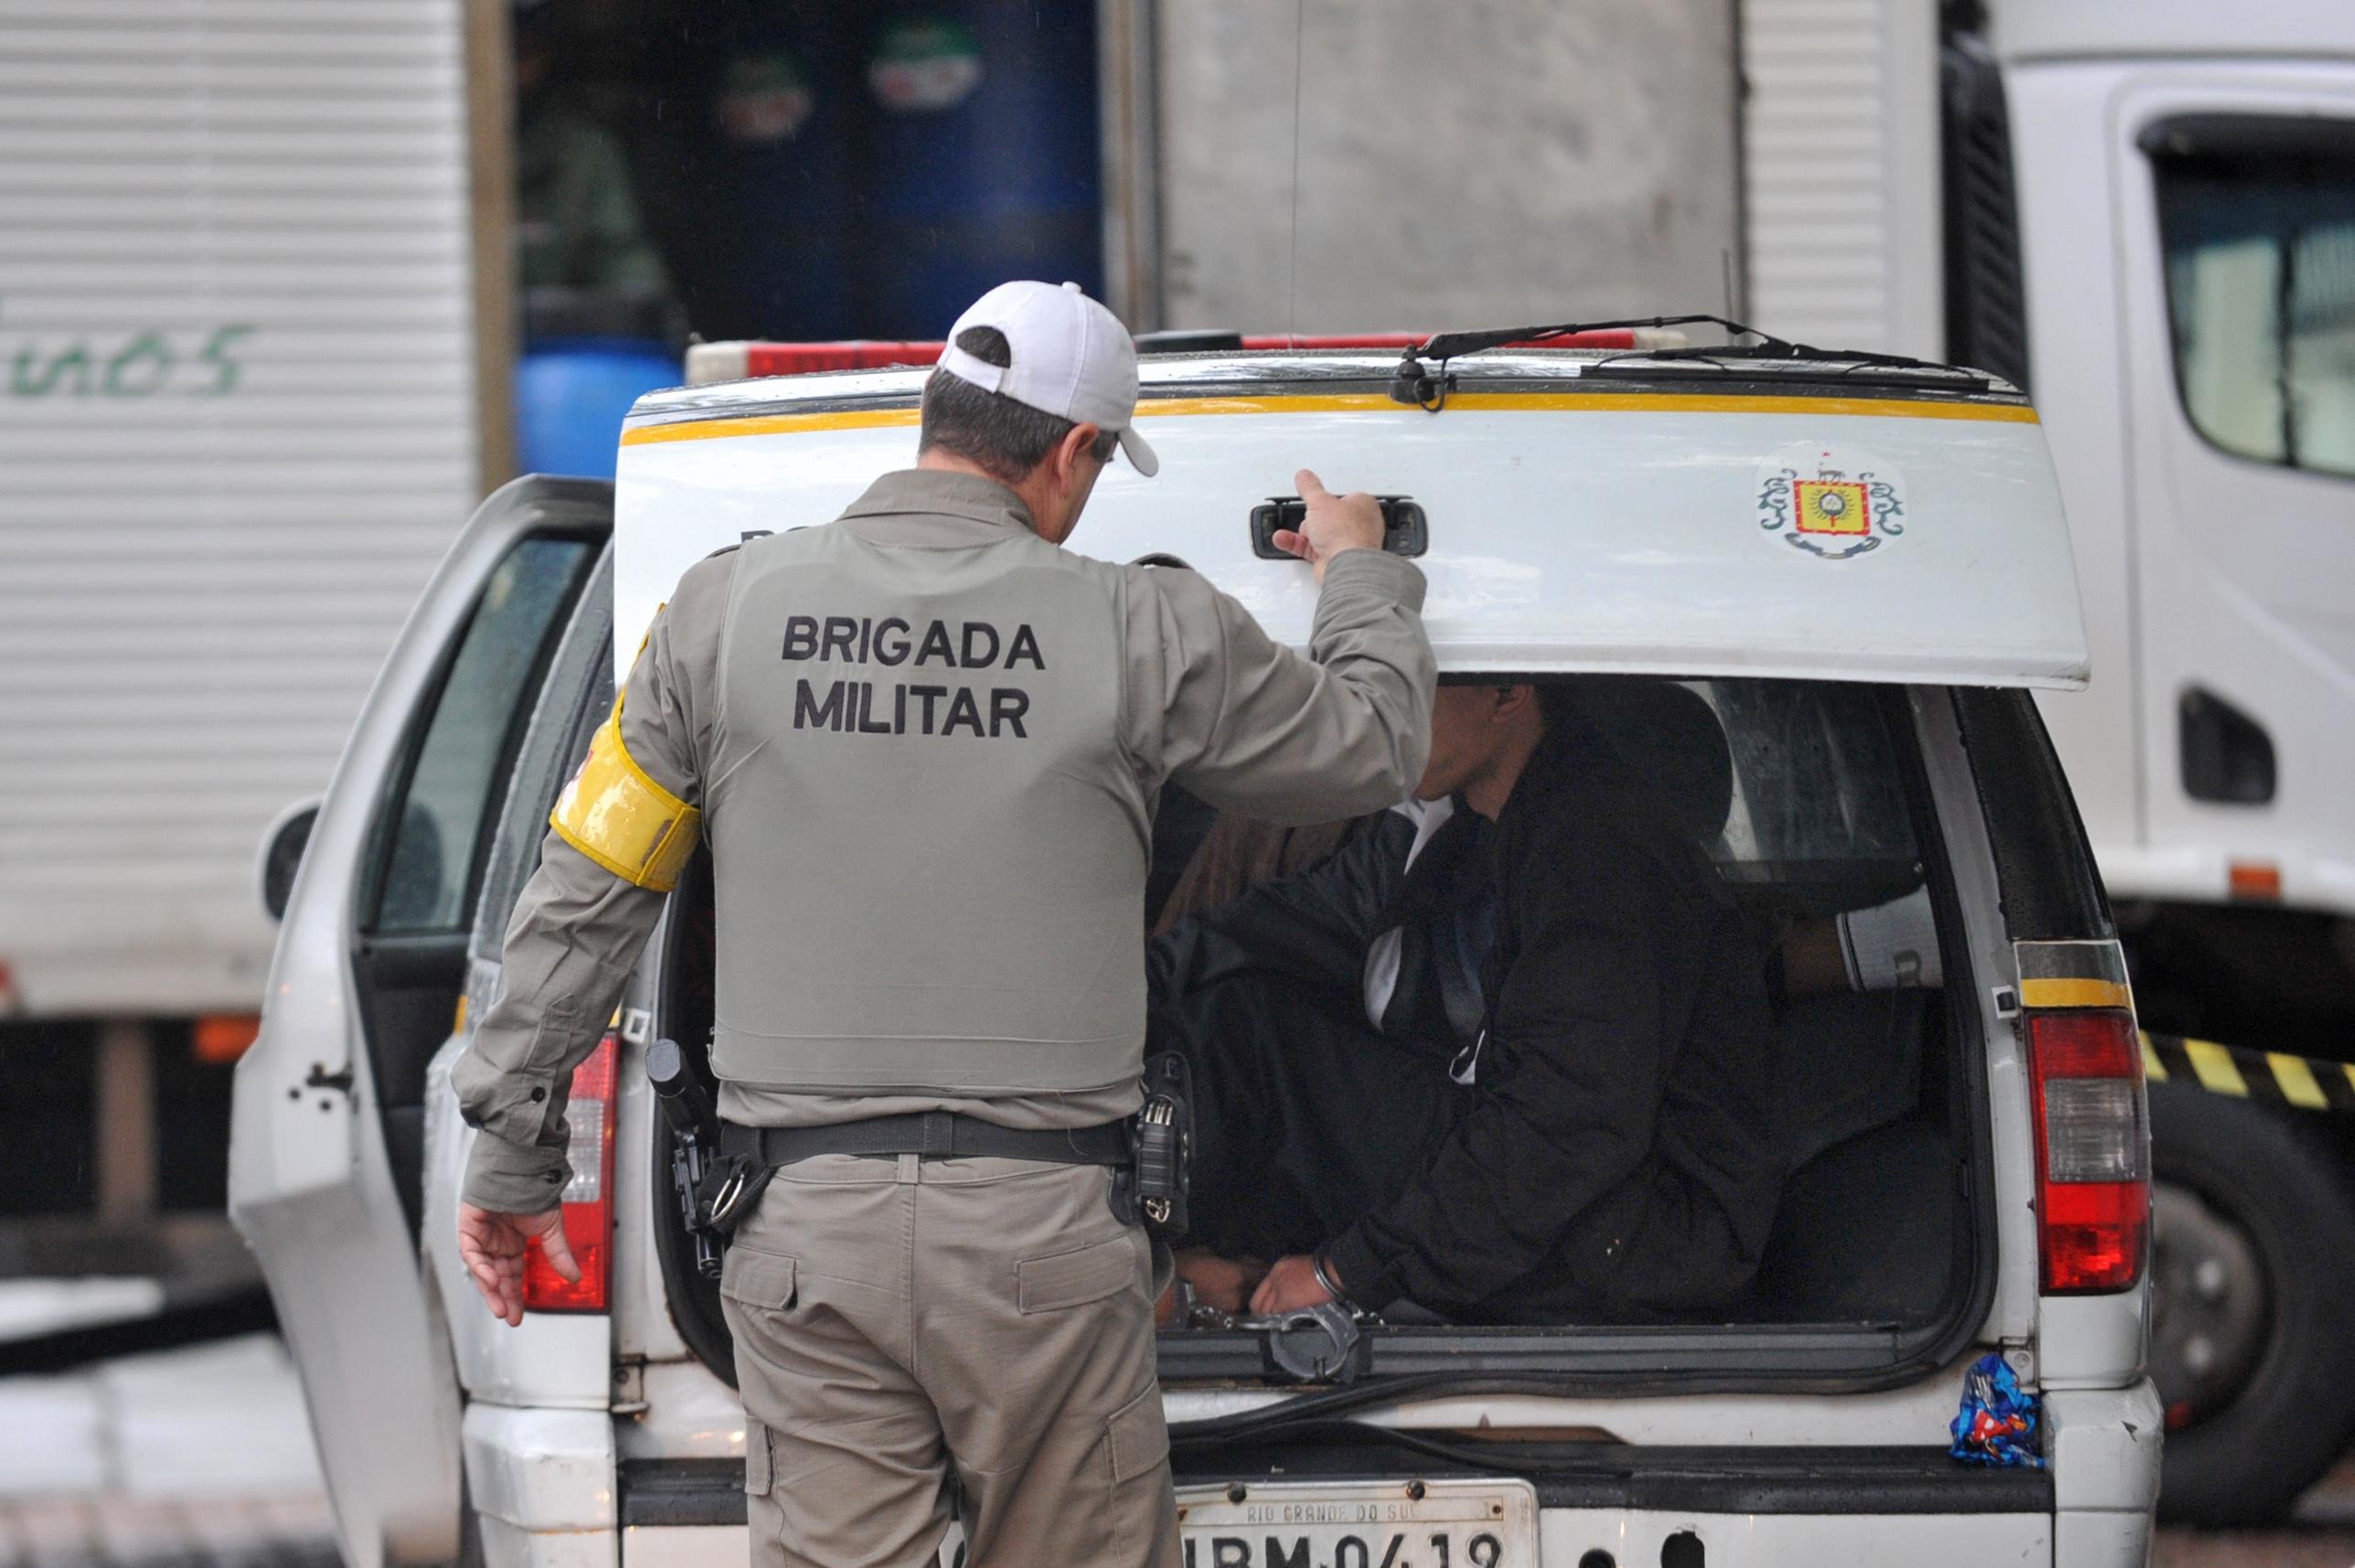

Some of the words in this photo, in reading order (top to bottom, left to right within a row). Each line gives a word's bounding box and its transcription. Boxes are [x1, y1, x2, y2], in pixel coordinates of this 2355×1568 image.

[782, 615, 1046, 670] BRIGADA
[793, 678, 1030, 739] MILITAR
[1246, 1505, 1274, 1522] RIO
[1357, 1504, 1379, 1521] DO
